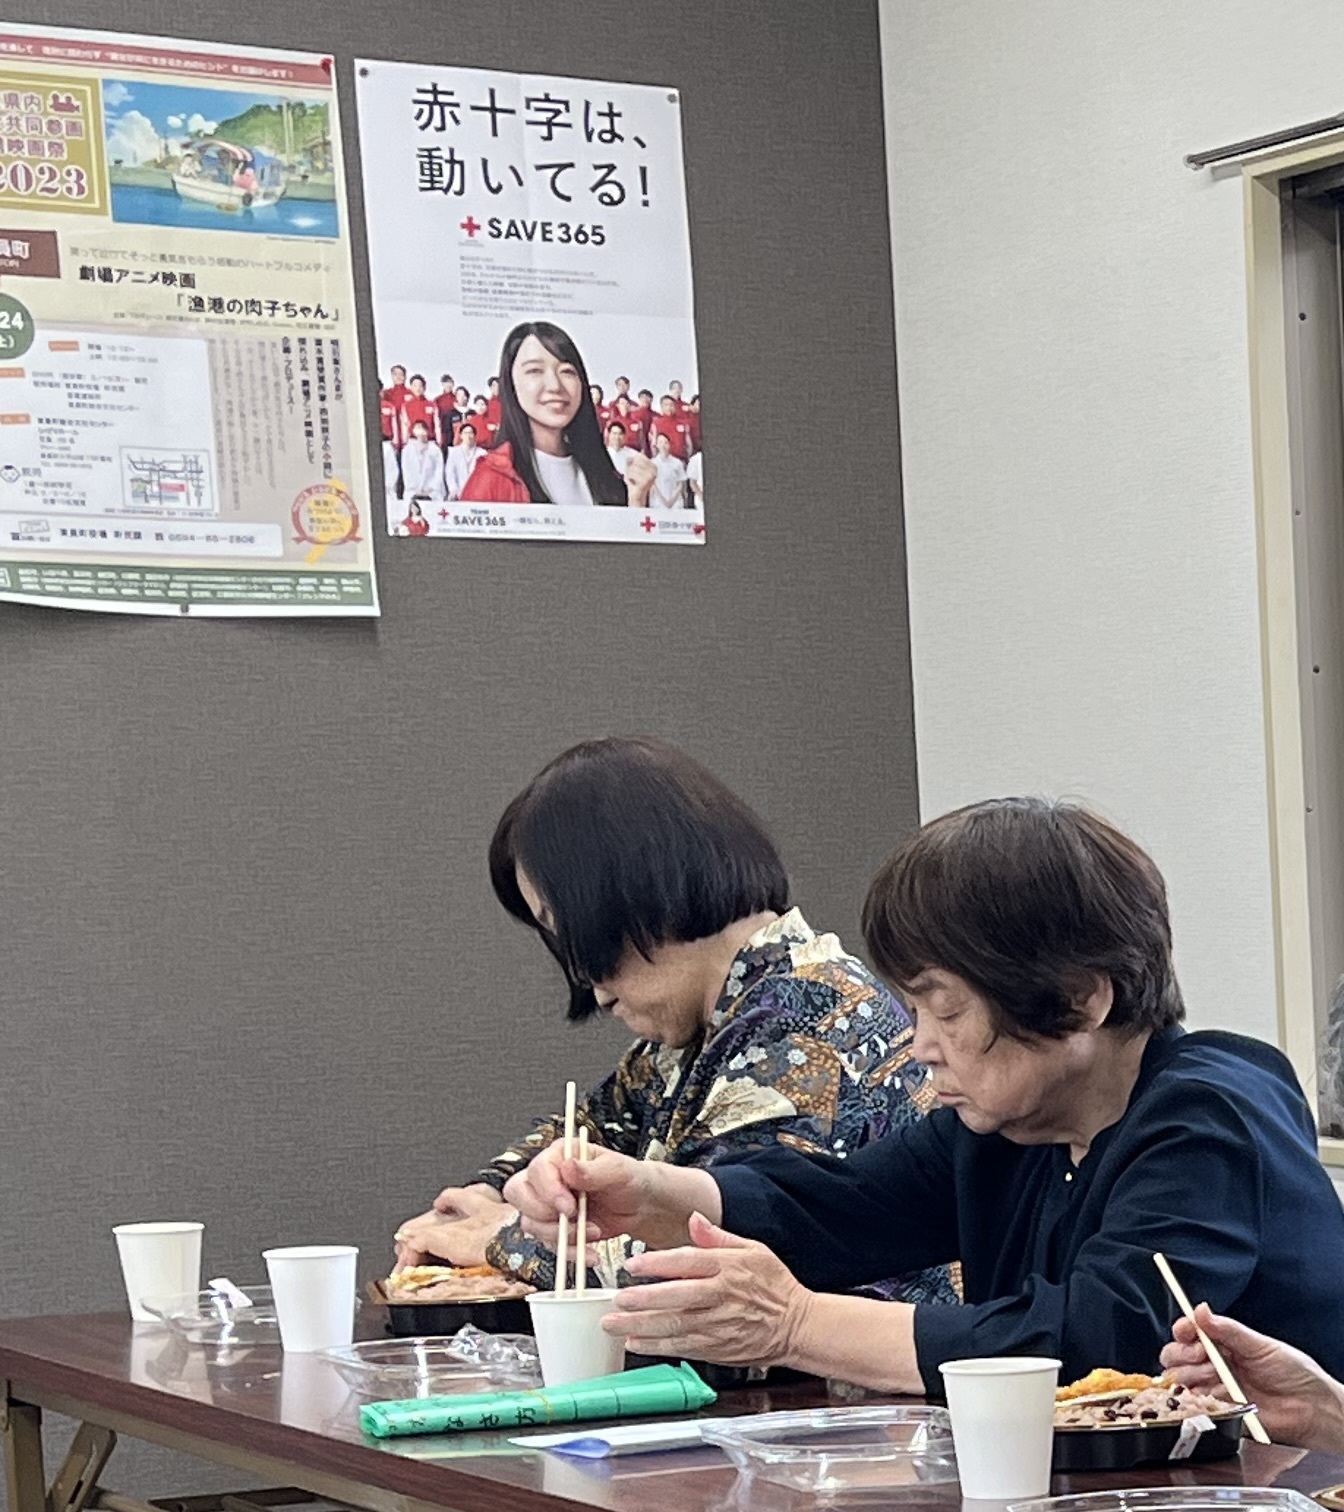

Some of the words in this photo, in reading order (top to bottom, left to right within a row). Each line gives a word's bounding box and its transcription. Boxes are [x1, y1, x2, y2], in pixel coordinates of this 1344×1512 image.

[0, 114, 83, 137] 共同参画
[412, 82, 647, 149] 赤十字は、
[0, 138, 66, 158] 映画祭
[416, 146, 651, 208] 動いてる！
[486, 216, 606, 247] SAVE365
[79, 265, 196, 290] 劇場アニメ映画
